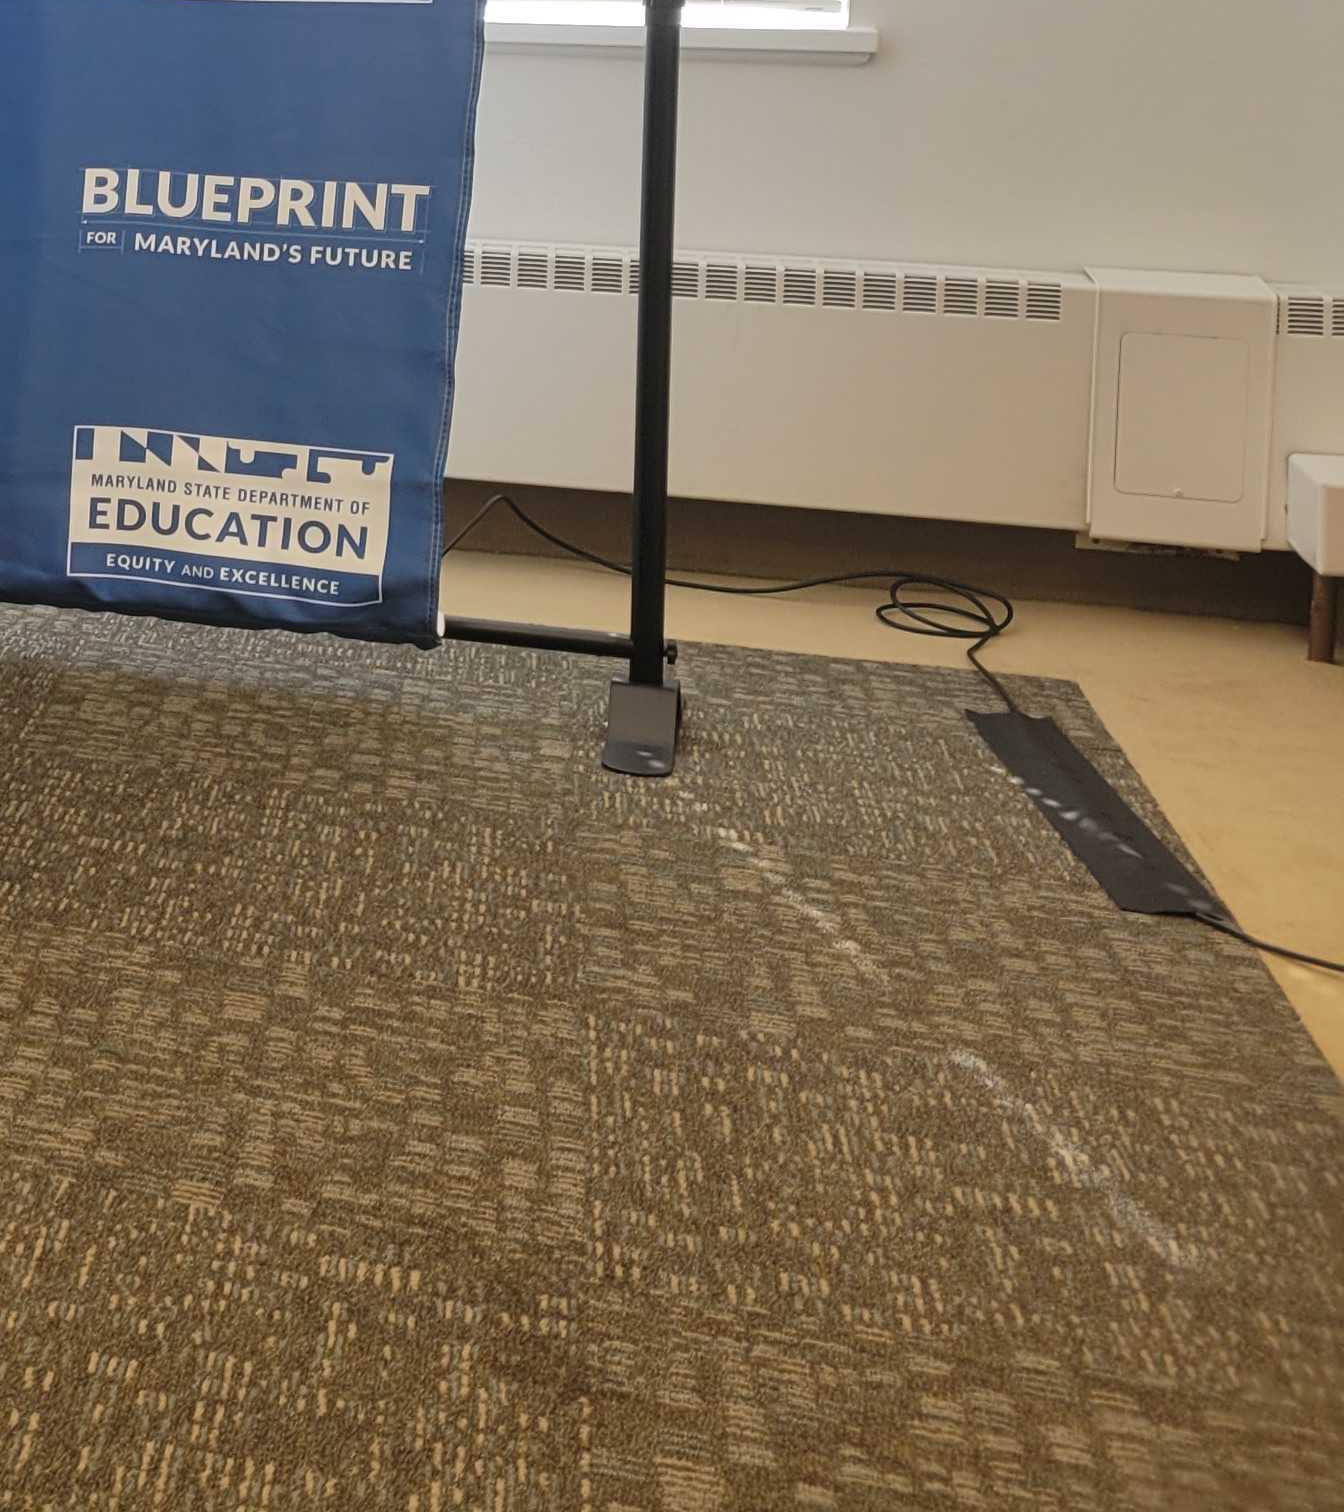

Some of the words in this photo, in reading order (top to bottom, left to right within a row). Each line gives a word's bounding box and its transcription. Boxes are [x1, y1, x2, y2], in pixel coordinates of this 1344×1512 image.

[82, 168, 430, 231] BLUEPRINT
[87, 232, 116, 244] FOR
[135, 233, 301, 263] MARYLAND'S
[311, 246, 412, 269] FUTURE
[92, 474, 176, 492] MARYLAND
[184, 482, 230, 500] STATE
[238, 488, 344, 512] DEPARTMENT
[350, 501, 370, 515] OF
[89, 496, 369, 559] EDUCATION
[107, 554, 175, 573] EQUITY
[182, 565, 214, 578] AND
[220, 567, 338, 594] EXCELLENCE
